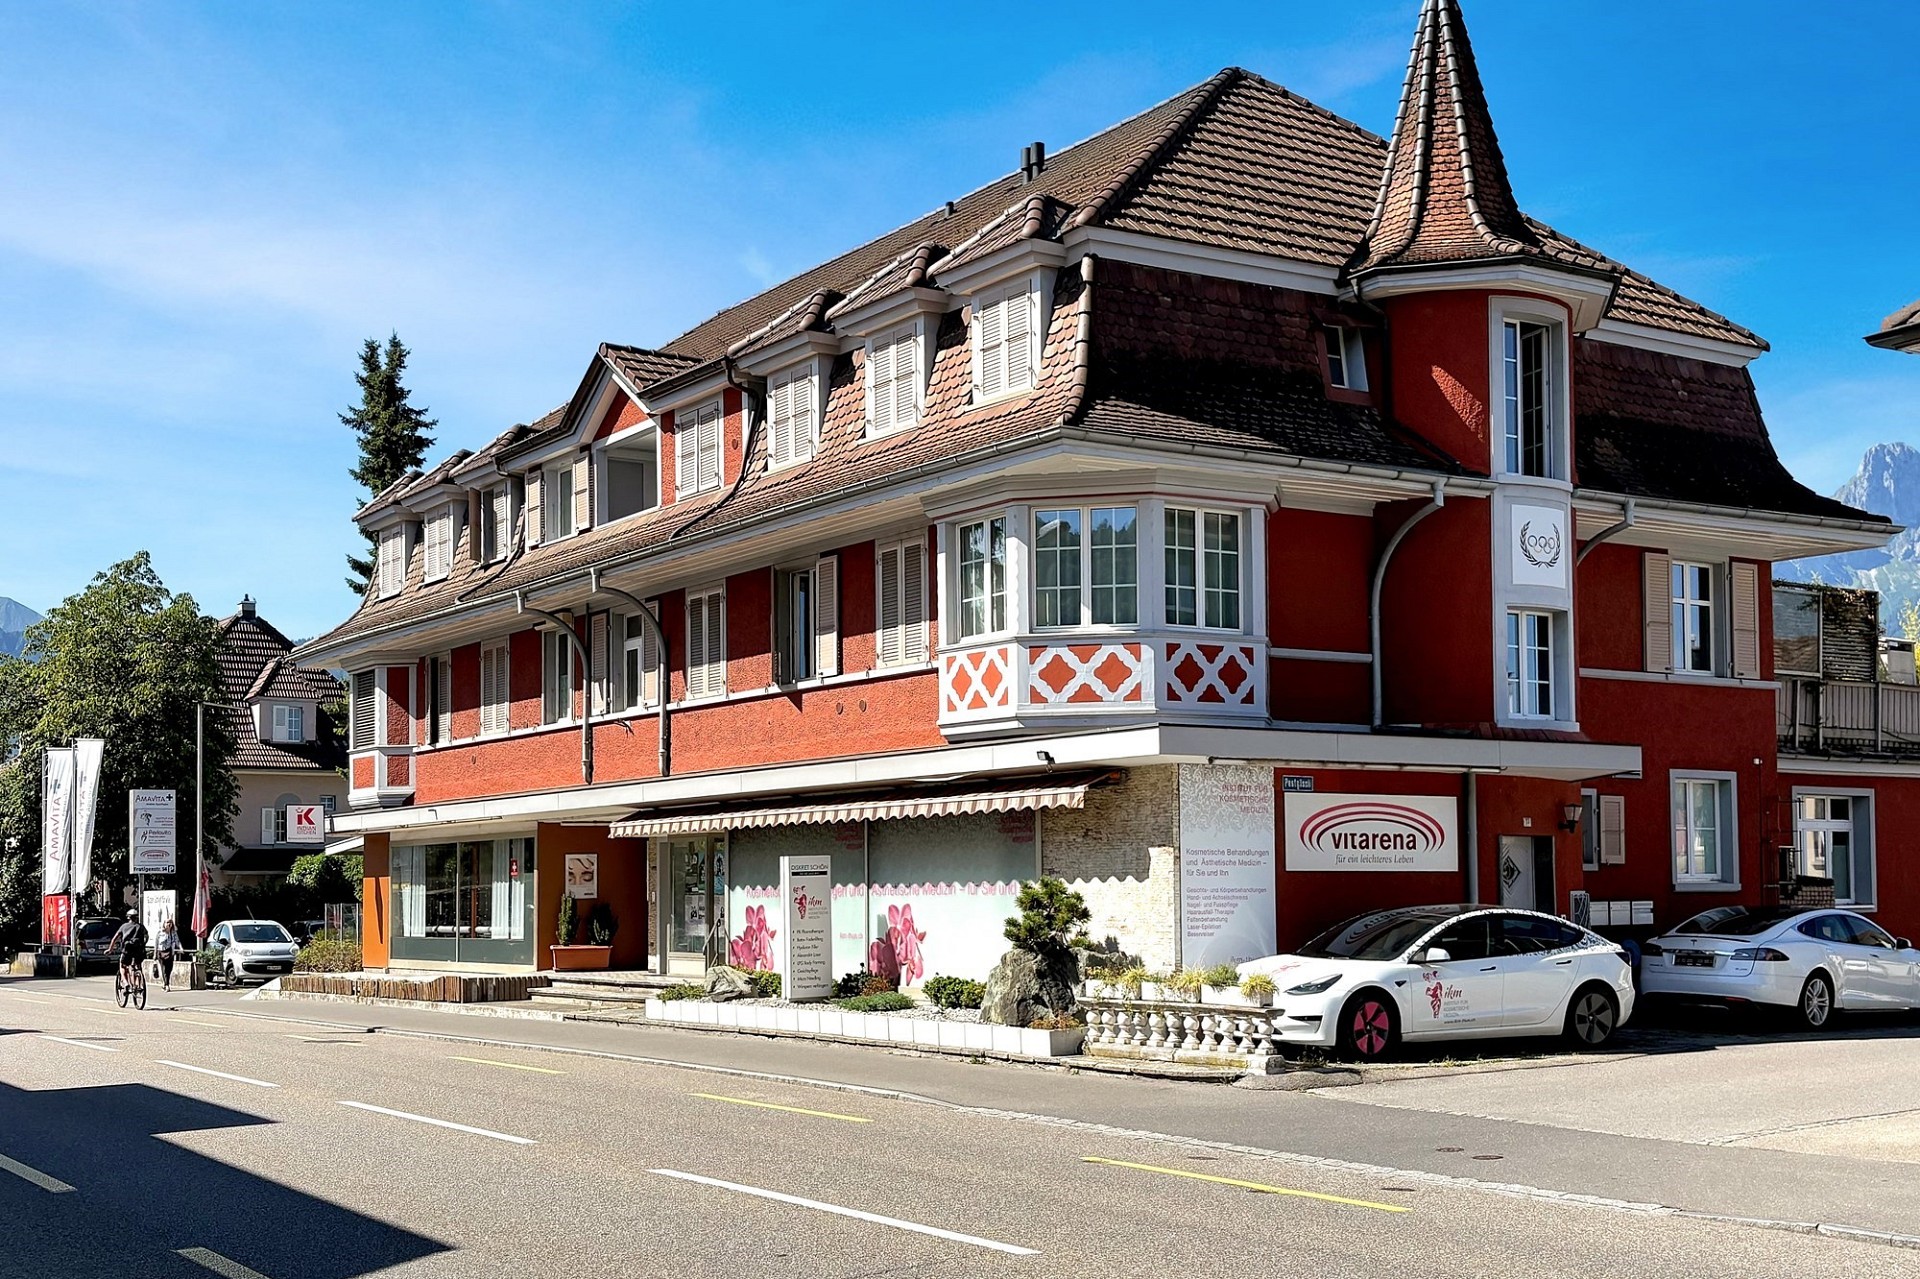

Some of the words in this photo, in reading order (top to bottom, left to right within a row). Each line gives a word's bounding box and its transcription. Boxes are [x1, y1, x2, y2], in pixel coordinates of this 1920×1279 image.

[49, 796, 62, 861] AMAVITA
[1331, 832, 1417, 850] vitarena
[1186, 848, 1226, 856] Kosmetische
[1226, 848, 1270, 857] Behandlungen
[1335, 854, 1346, 865] für
[1347, 854, 1359, 863] ein
[1360, 854, 1392, 864] leichteres
[1393, 854, 1414, 864] Leben
[1186, 868, 1195, 876] für
[1195, 868, 1206, 876] Sie
[1444, 984, 1463, 999] ikm
